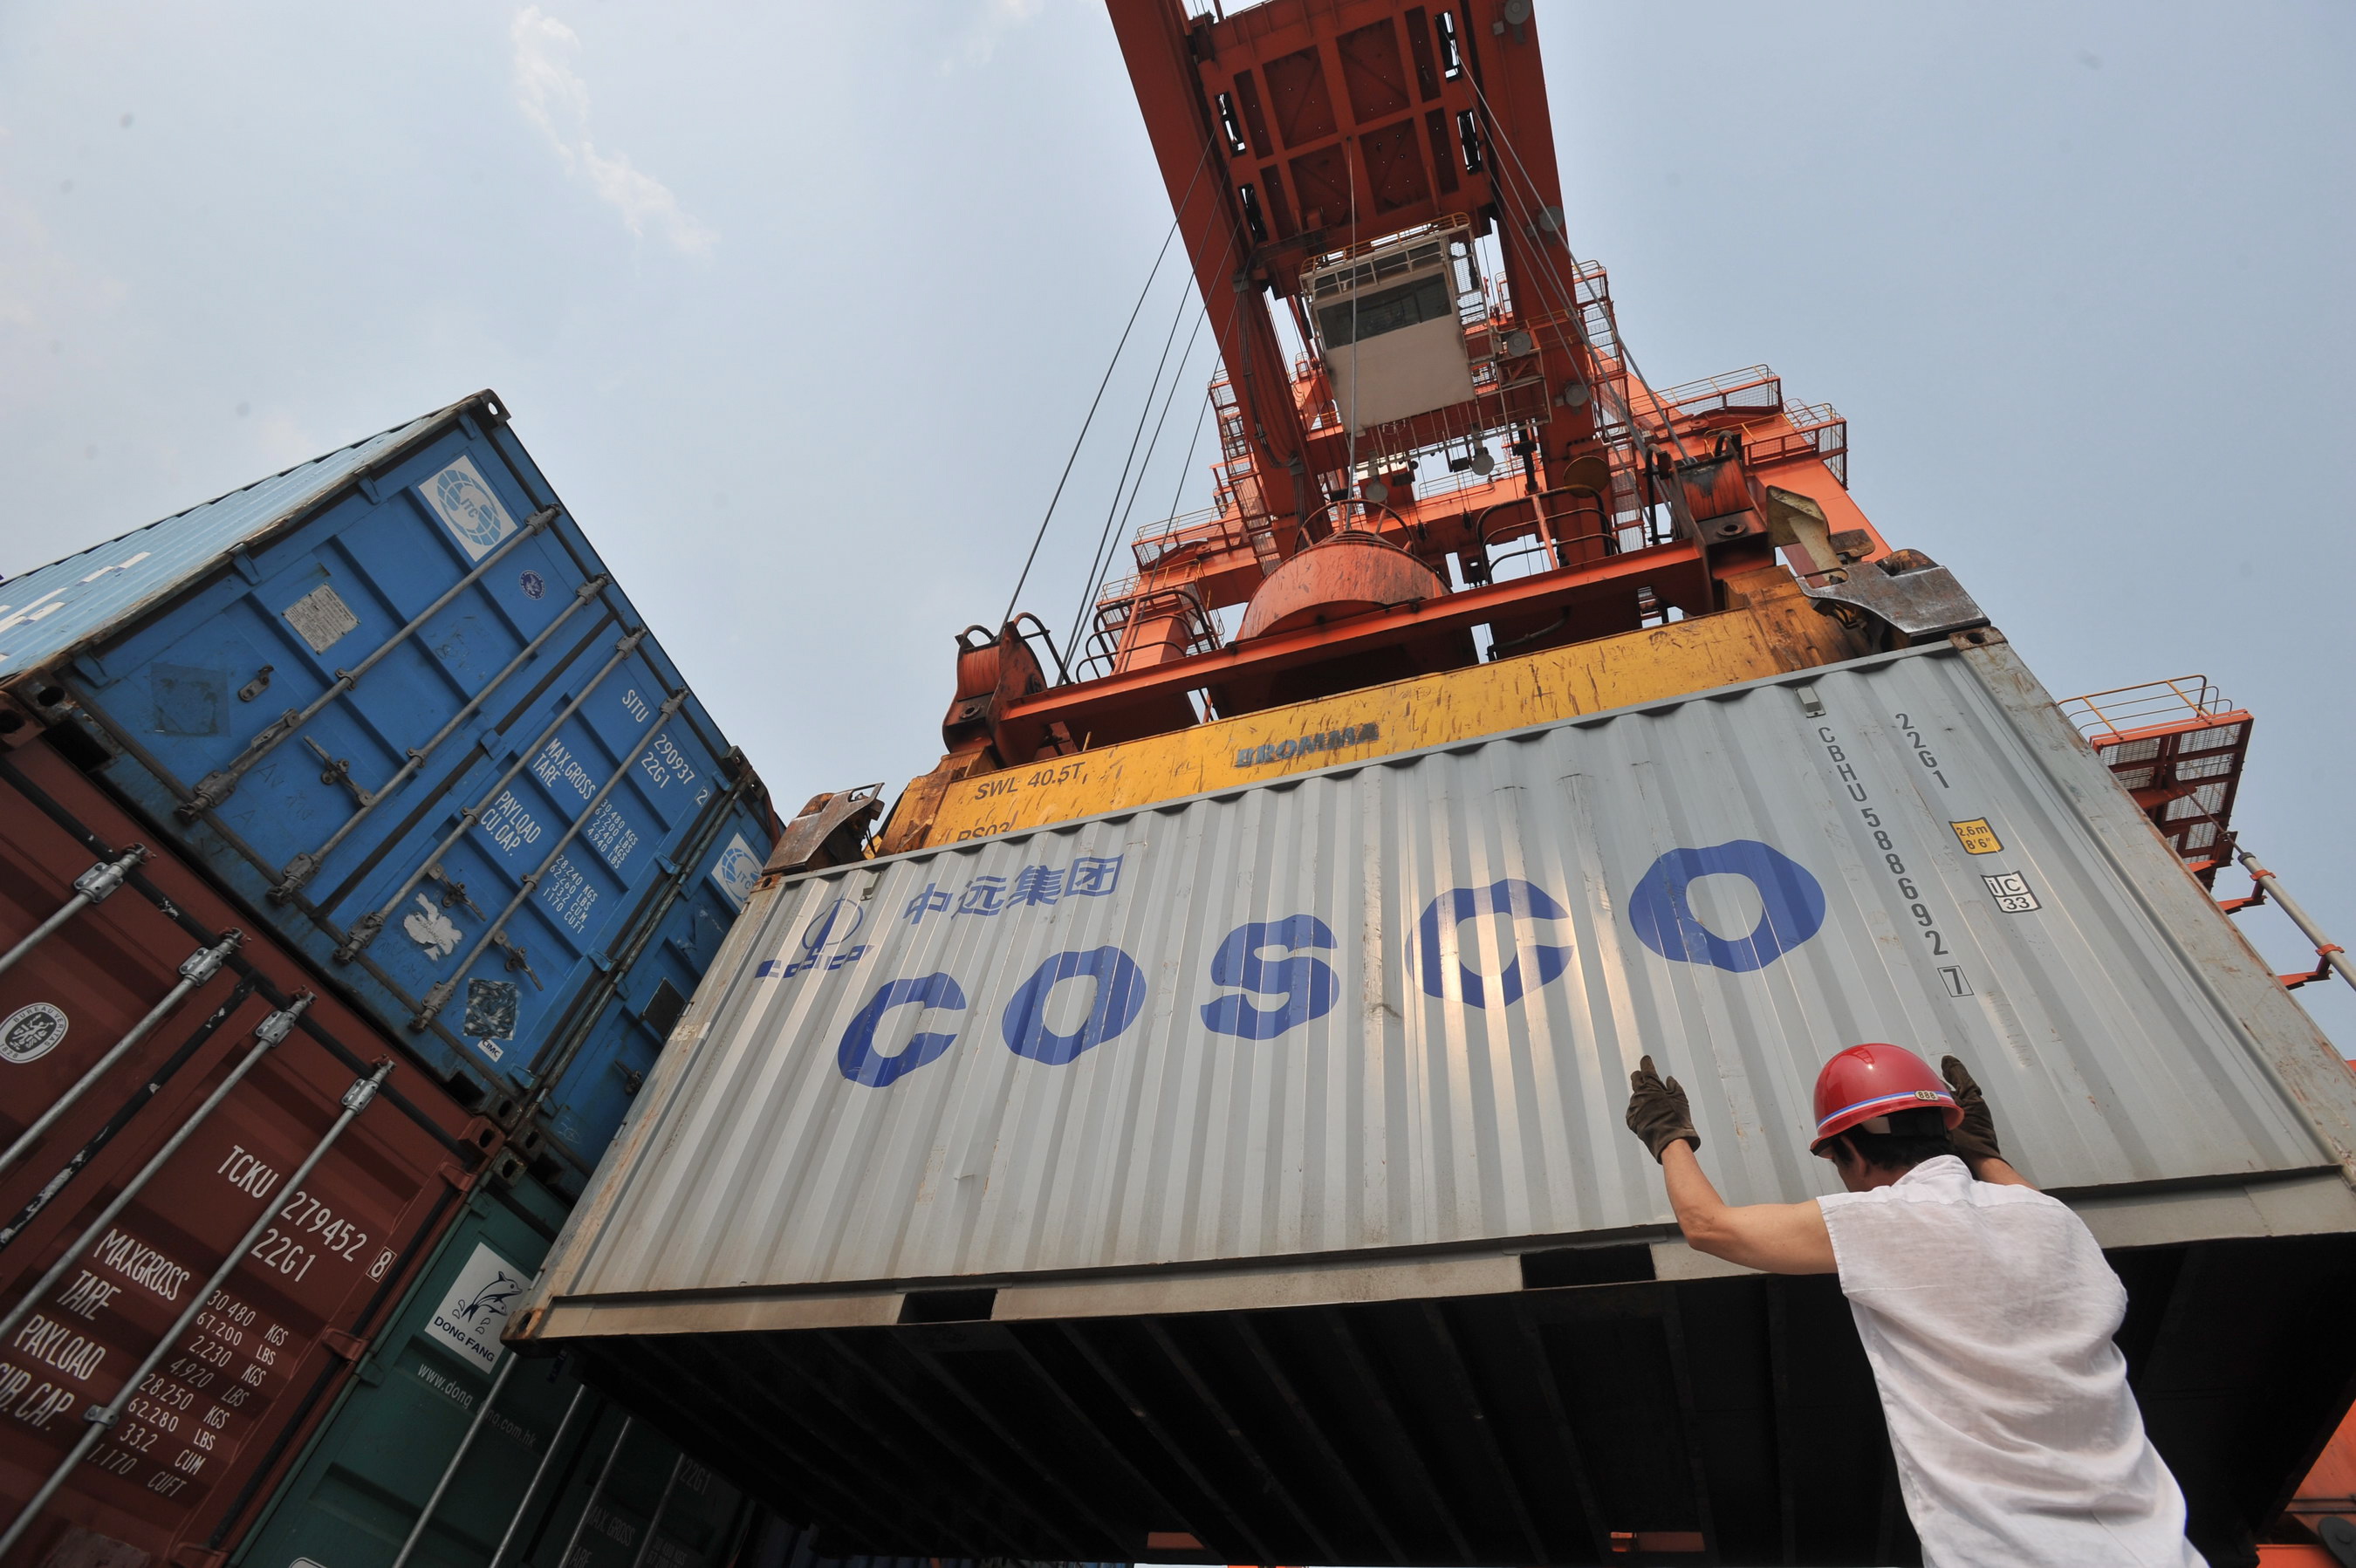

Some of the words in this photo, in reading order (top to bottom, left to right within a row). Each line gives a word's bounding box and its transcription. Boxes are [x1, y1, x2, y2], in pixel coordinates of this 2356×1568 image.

[461, 498, 479, 517] ITC
[622, 689, 649, 722] SITU
[654, 734, 695, 784] 290937
[696, 789, 709, 805] 2
[1895, 713, 1950, 789] 22G1
[533, 753, 561, 788] TARE
[641, 751, 670, 789] 22G1
[974, 777, 1018, 800] SWL
[1028, 762, 1086, 788] 40.5T
[495, 791, 541, 844] PAYLOAD
[595, 808, 620, 837] 67.200
[619, 836, 633, 853] LBS
[601, 798, 626, 829] 30.480
[625, 829, 638, 846] KGS
[593, 819, 613, 845] 2.240
[613, 844, 627, 861] KGS
[556, 854, 583, 886] 28.240
[582, 884, 598, 902] KGS
[607, 852, 621, 869] LBS
[543, 887, 564, 912] 1170
[552, 882, 571, 904] 33.2
[737, 871, 750, 890] ITC
[902, 853, 1124, 924] 中远集团
[576, 893, 592, 911] LBS
[2003, 897, 2031, 910] 33
[837, 839, 1825, 1087] COSCO
[1942, 968, 1962, 996] 7
[13, 1006, 54, 1024] BUREAU
[44, 1013, 65, 1047] VERITAS
[482, 1038, 502, 1058] CIMC
[217, 1145, 279, 1199] TCKU
[280, 1191, 367, 1262] 279452
[370, 1250, 393, 1278] 8
[250, 1228, 316, 1283] 22G1
[57, 1270, 122, 1321] TARE
[13, 1313, 106, 1380] PAYLOAD
[196, 1311, 243, 1345] 67.200
[256, 1344, 277, 1366] LBS
[264, 1324, 289, 1346] KGS
[434, 1316, 465, 1342] DONG
[464, 1337, 496, 1362] FANG
[241, 1363, 267, 1387] KGS
[221, 1385, 250, 1407] LBS
[203, 1405, 230, 1429] KGS
[120, 1423, 158, 1453] 33.2
[175, 1448, 206, 1476] CUM
[194, 1428, 216, 1451] LBS
[147, 1470, 188, 1497] CUFT
[679, 1458, 712, 1496] 22G1
